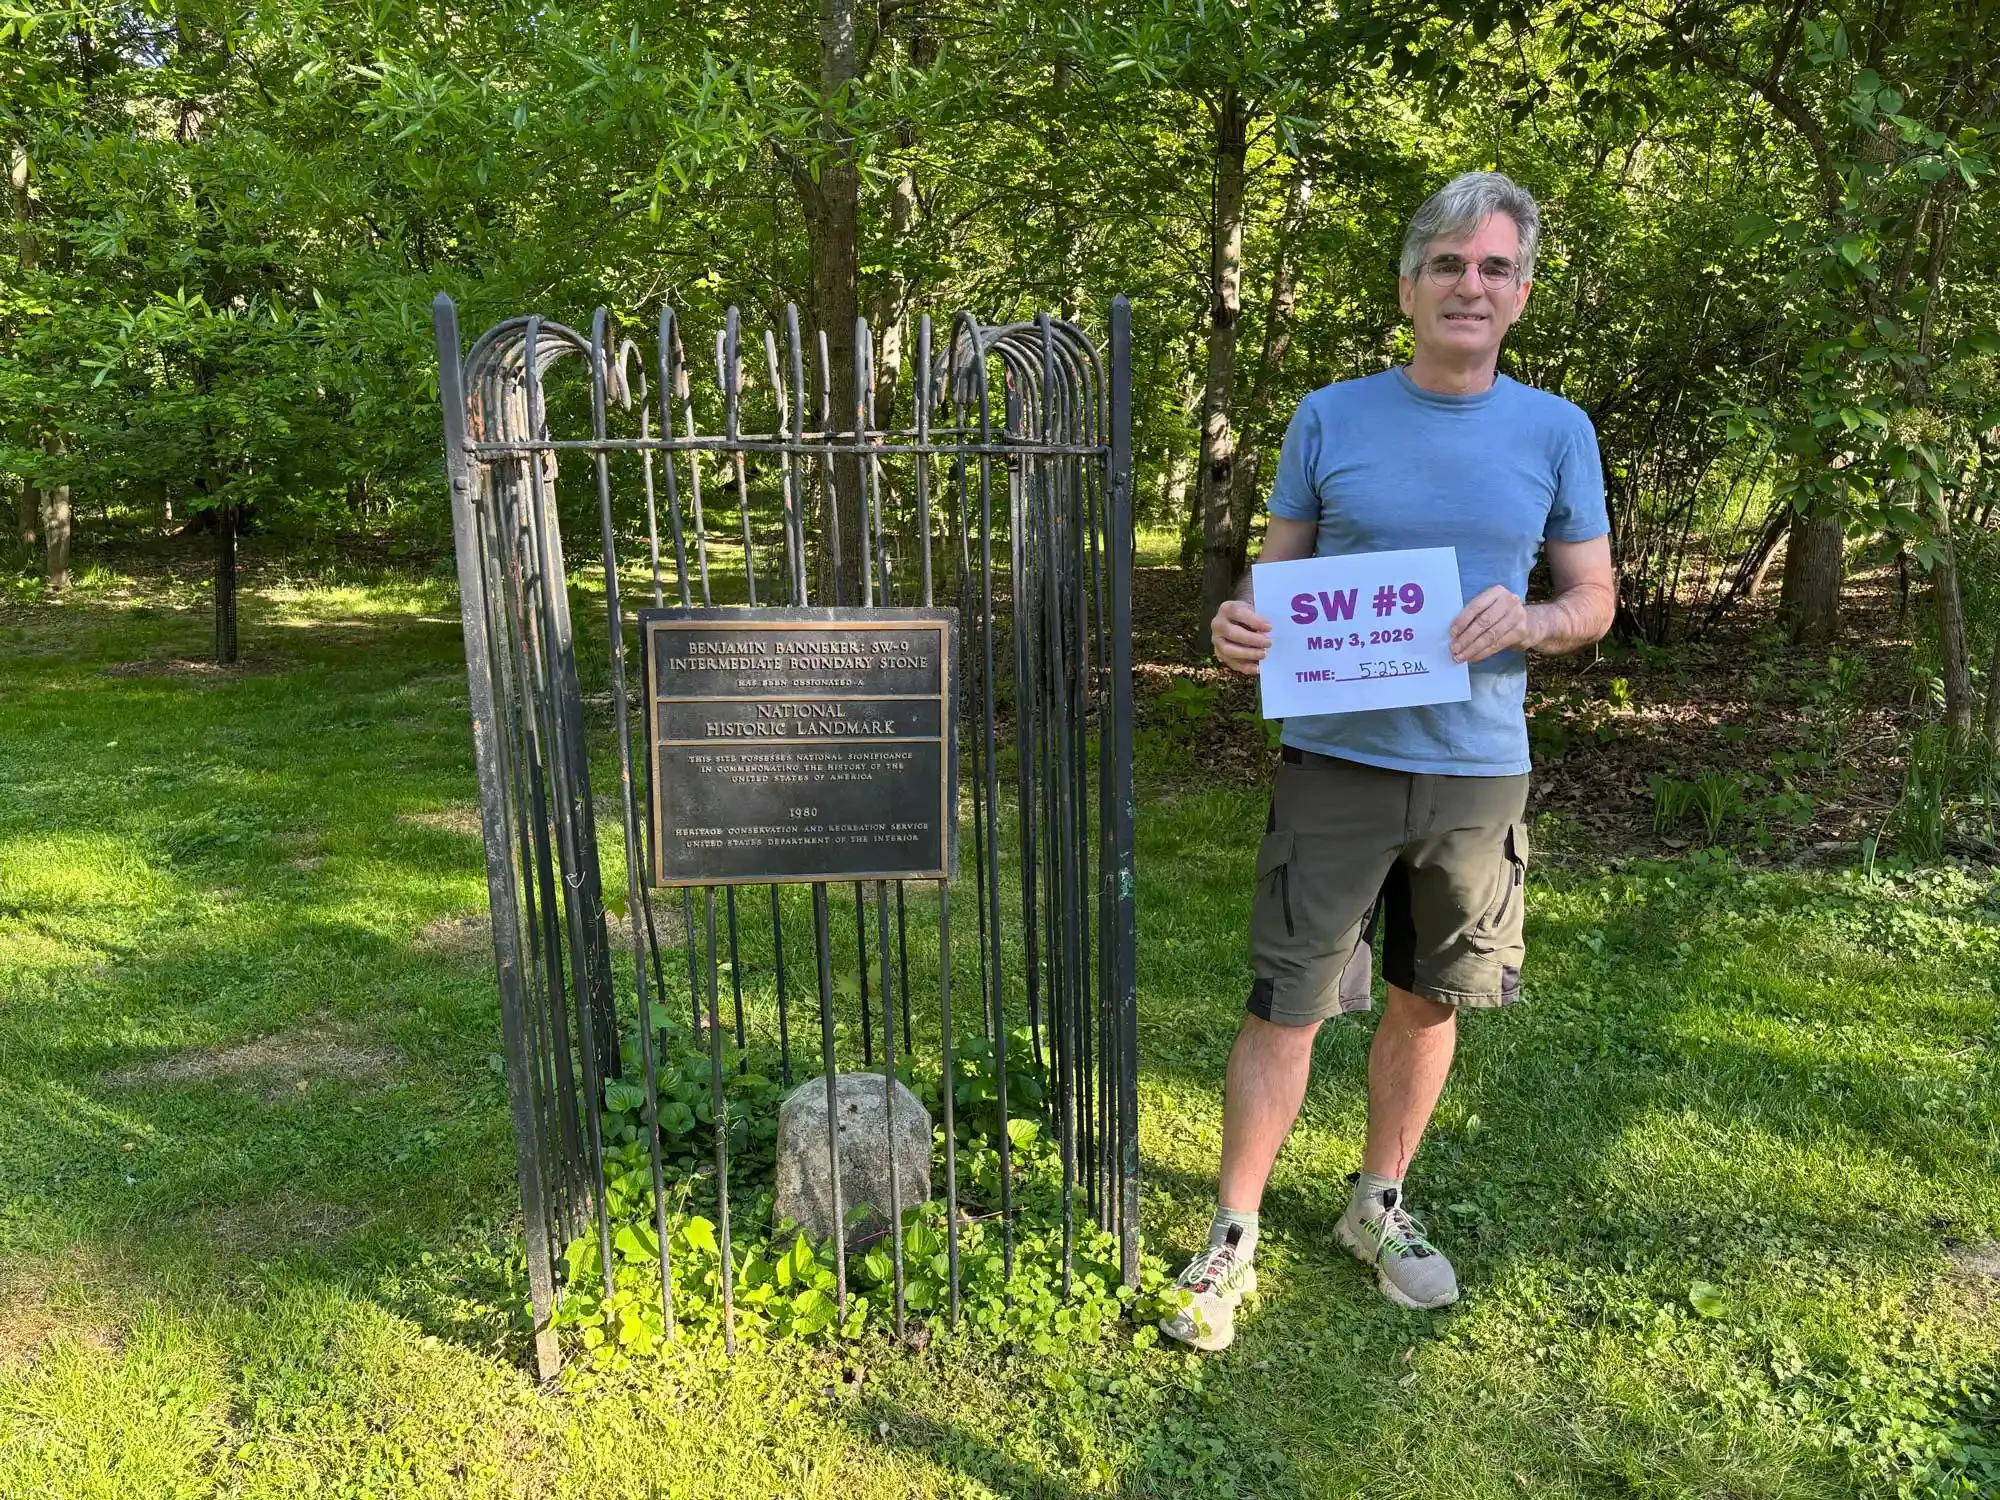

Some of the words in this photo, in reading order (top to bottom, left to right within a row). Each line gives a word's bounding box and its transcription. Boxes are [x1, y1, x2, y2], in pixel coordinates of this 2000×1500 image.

[1290, 588, 1359, 625] SW
[1372, 583, 1425, 617] #9
[1307, 636, 1343, 651] May
[1349, 633, 1365, 648] 3,
[1370, 628, 1414, 645] 2026
[688, 641, 766, 655] BENJAMIN
[775, 641, 865, 654] BANNEKER:
[872, 640, 909, 654] SW-9
[669, 657, 782, 670] INTERMEDIATE
[790, 656, 873, 669] BOUNDARY
[880, 656, 928, 669] STONE
[1359, 661, 1399, 679] 5:25
[738, 679, 757, 687] HAS
[762, 679, 787, 687] BEEN
[793, 679, 851, 687] DESIGNATED
[1295, 669, 1336, 683] TIME:
[756, 704, 845, 719] NATIONAL
[706, 722, 786, 737] HISTORIC
[797, 720, 896, 736] LANDMARK
[688, 755, 712, 763] THIS
[741, 753, 793, 762] POSSESSES
[796, 753, 843, 761] NATIONAL
[848, 752, 913, 760] SIGNIFICANCE
[716, 765, 799, 773] COMMEMORATING
[886, 762, 904, 770] THE
[789, 807, 818, 818] 1980
[675, 828, 722, 836] HERITAGE
[728, 826, 798, 835] CONSERVATION
[804, 825, 824, 833] AND
[828, 824, 886, 832] RECREATION
[891, 822, 929, 830] SERVICE
[686, 839, 723, 848] UNITED
[727, 838, 763, 846] STATES
[768, 836, 830, 846] DEPARTMENT
[851, 835, 868, 843] THE
[874, 834, 919, 842] INTERIOR
